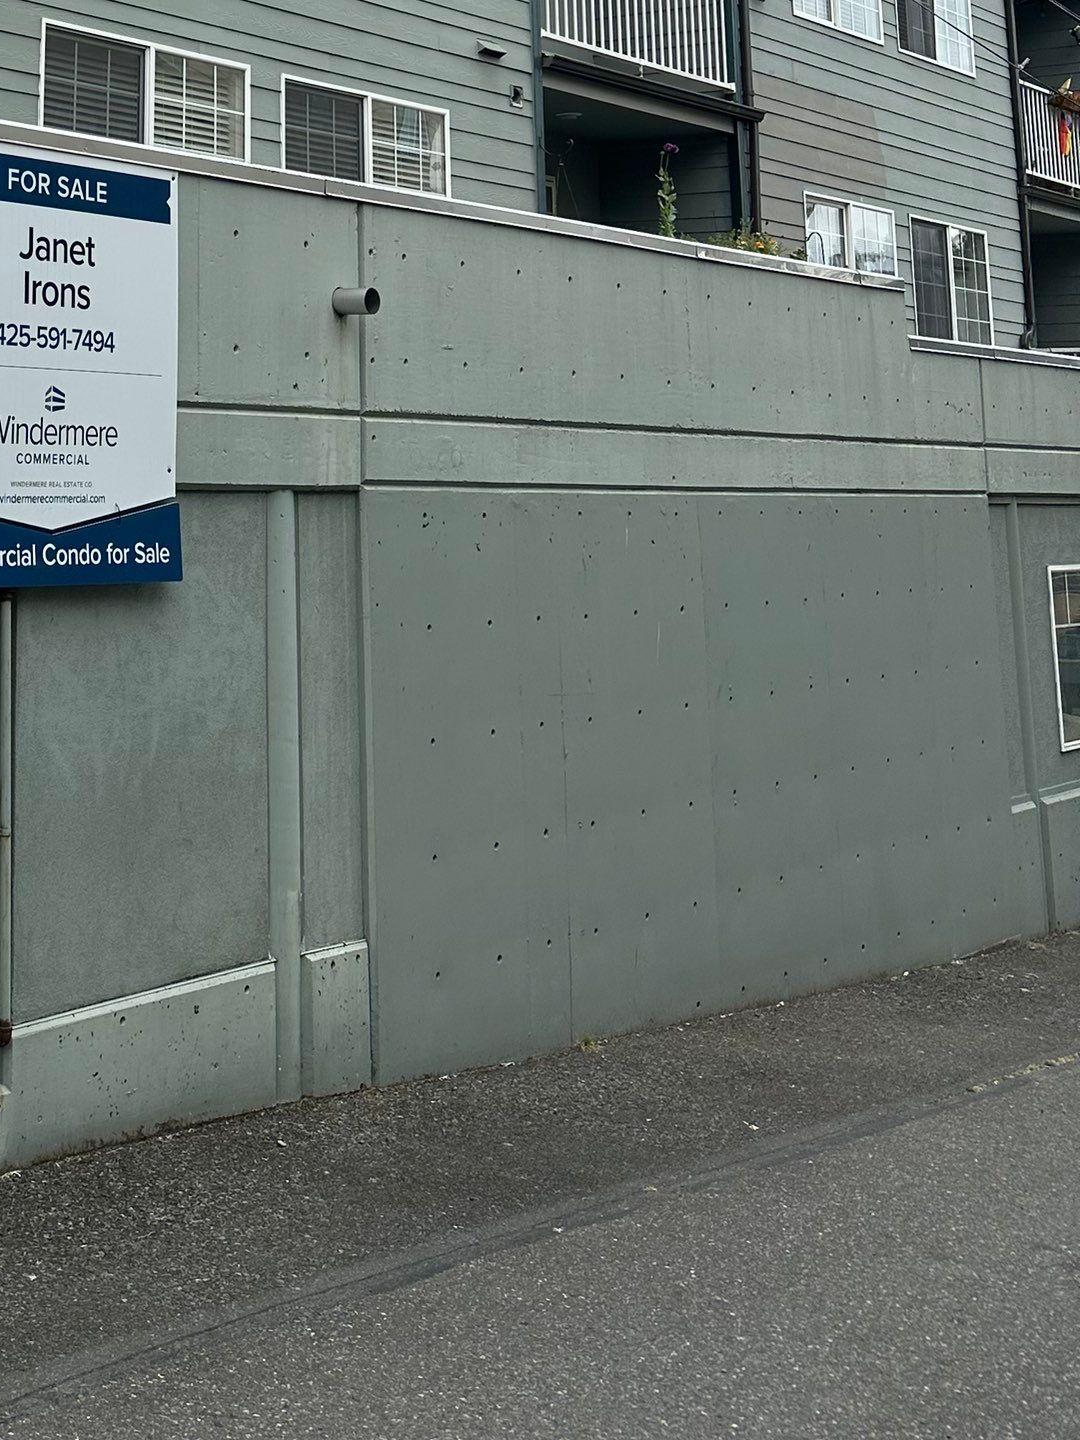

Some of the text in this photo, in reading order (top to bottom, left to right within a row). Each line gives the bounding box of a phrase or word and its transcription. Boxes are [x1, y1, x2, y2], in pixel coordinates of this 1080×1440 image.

[7, 167, 108, 203] FOR SALE
[18, 227, 96, 267] Janet
[24, 271, 91, 310] Irons
[16, 453, 90, 465] COMMERCIAL
[42, 543, 102, 566] Condo
[106, 542, 130, 564] for
[134, 542, 171, 564] Sale
